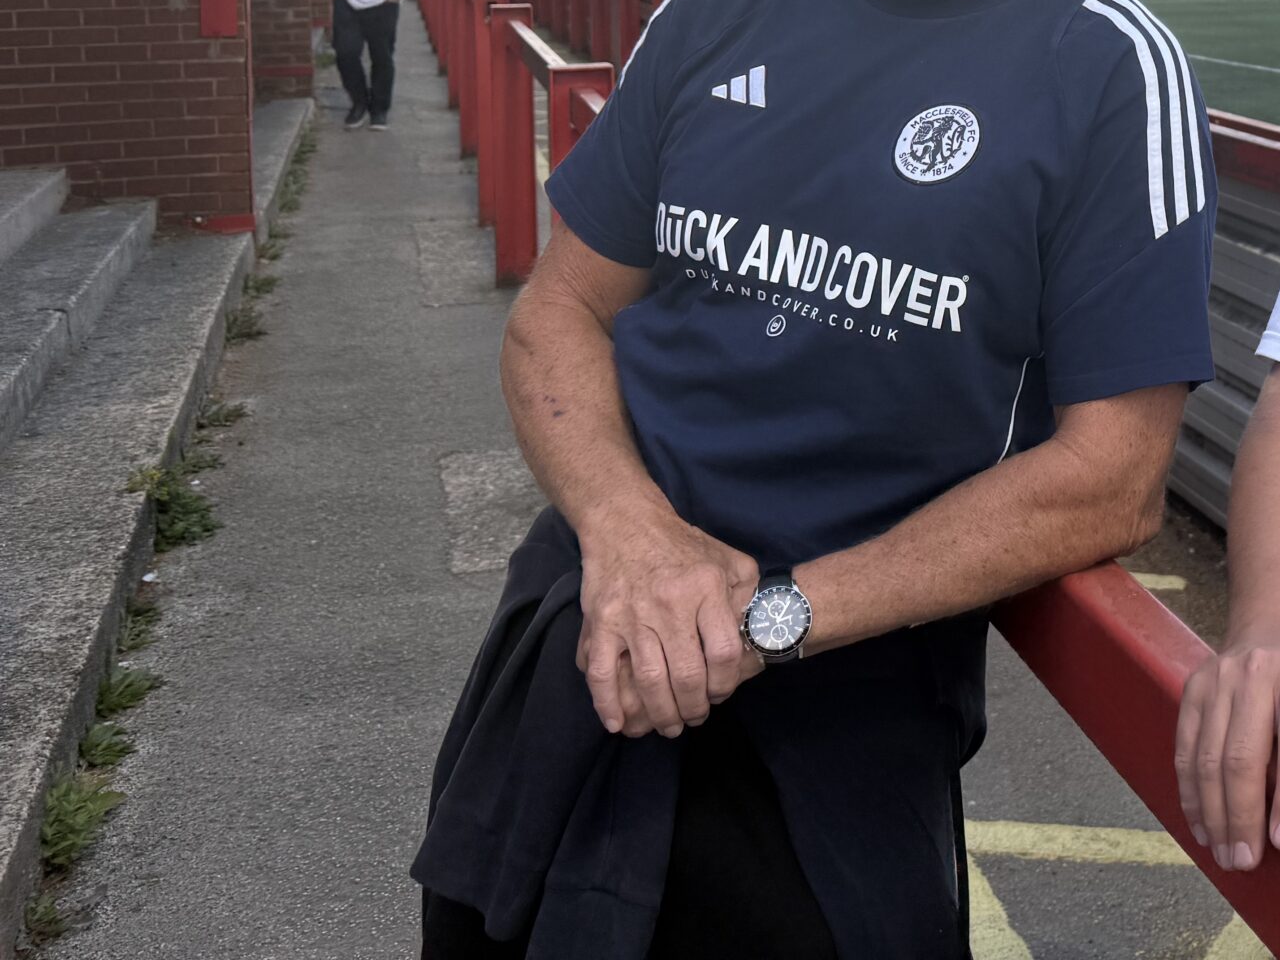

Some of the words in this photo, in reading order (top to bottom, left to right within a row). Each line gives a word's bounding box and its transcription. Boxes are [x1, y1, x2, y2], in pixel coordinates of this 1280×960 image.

[910, 107, 974, 129] MACCLESFIELD
[967, 129, 976, 143] FC
[898, 152, 919, 175] SINCE
[932, 163, 954, 177] 1874
[737, 224, 828, 292] AND
[824, 244, 968, 332] COVER
